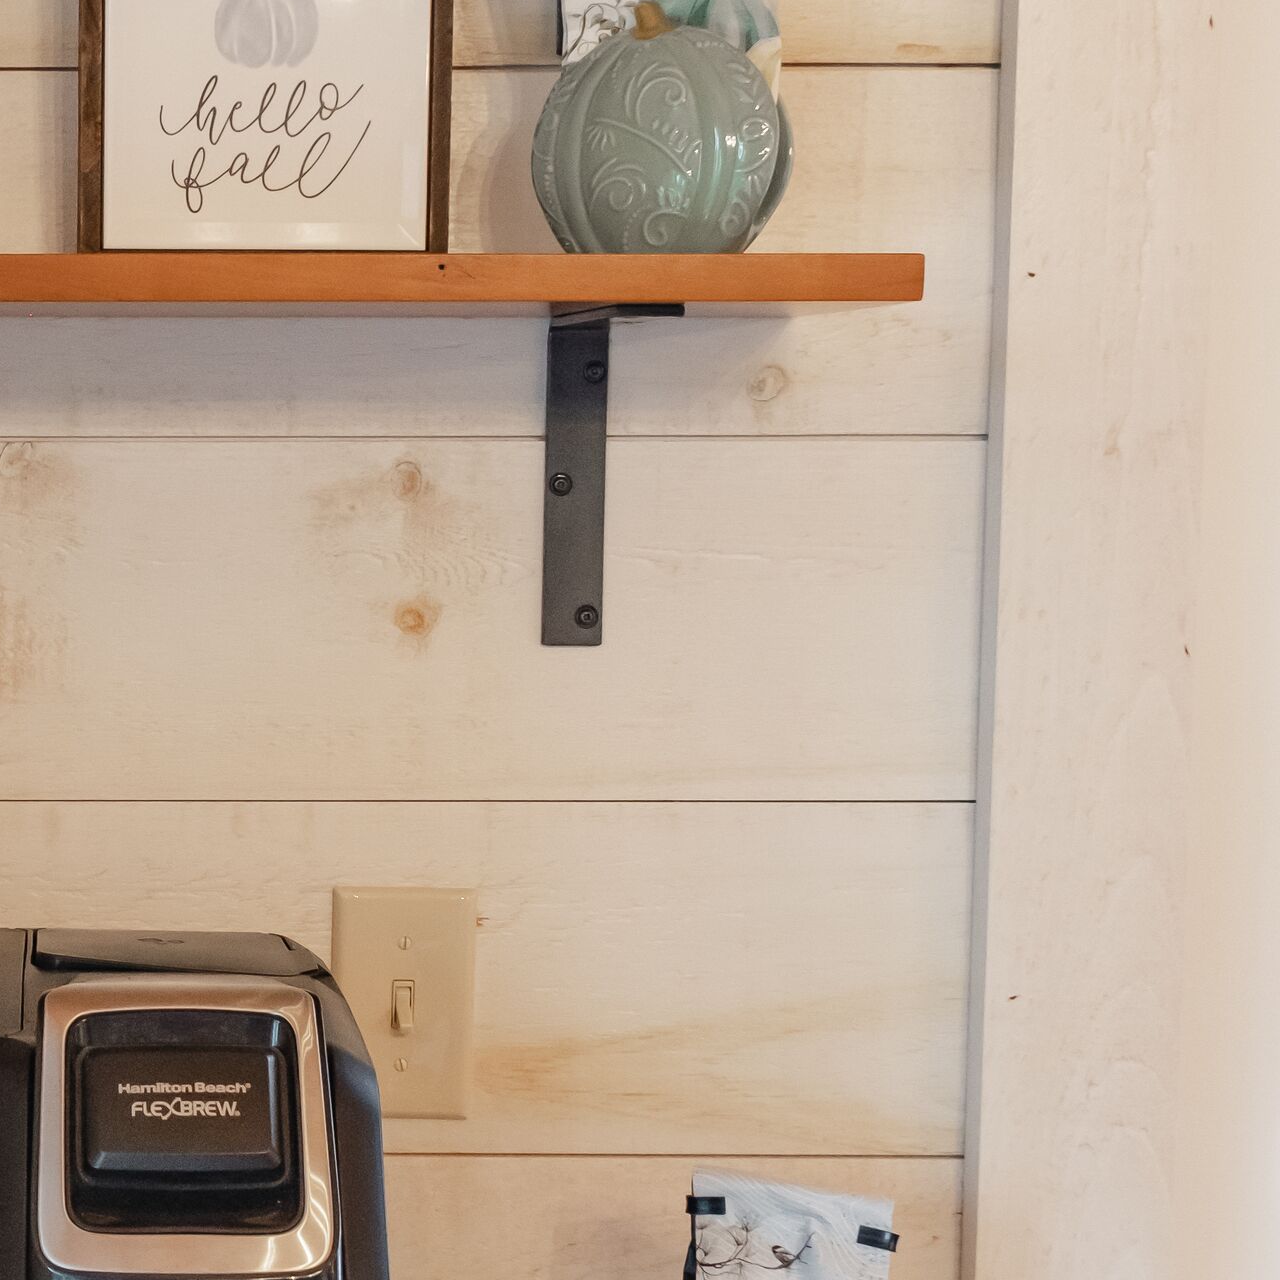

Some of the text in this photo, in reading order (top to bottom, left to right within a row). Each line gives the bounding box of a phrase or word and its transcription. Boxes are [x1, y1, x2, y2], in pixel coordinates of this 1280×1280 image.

[159, 75, 364, 145] hello
[171, 120, 371, 213] fall
[118, 1082, 193, 1094] Hamilton
